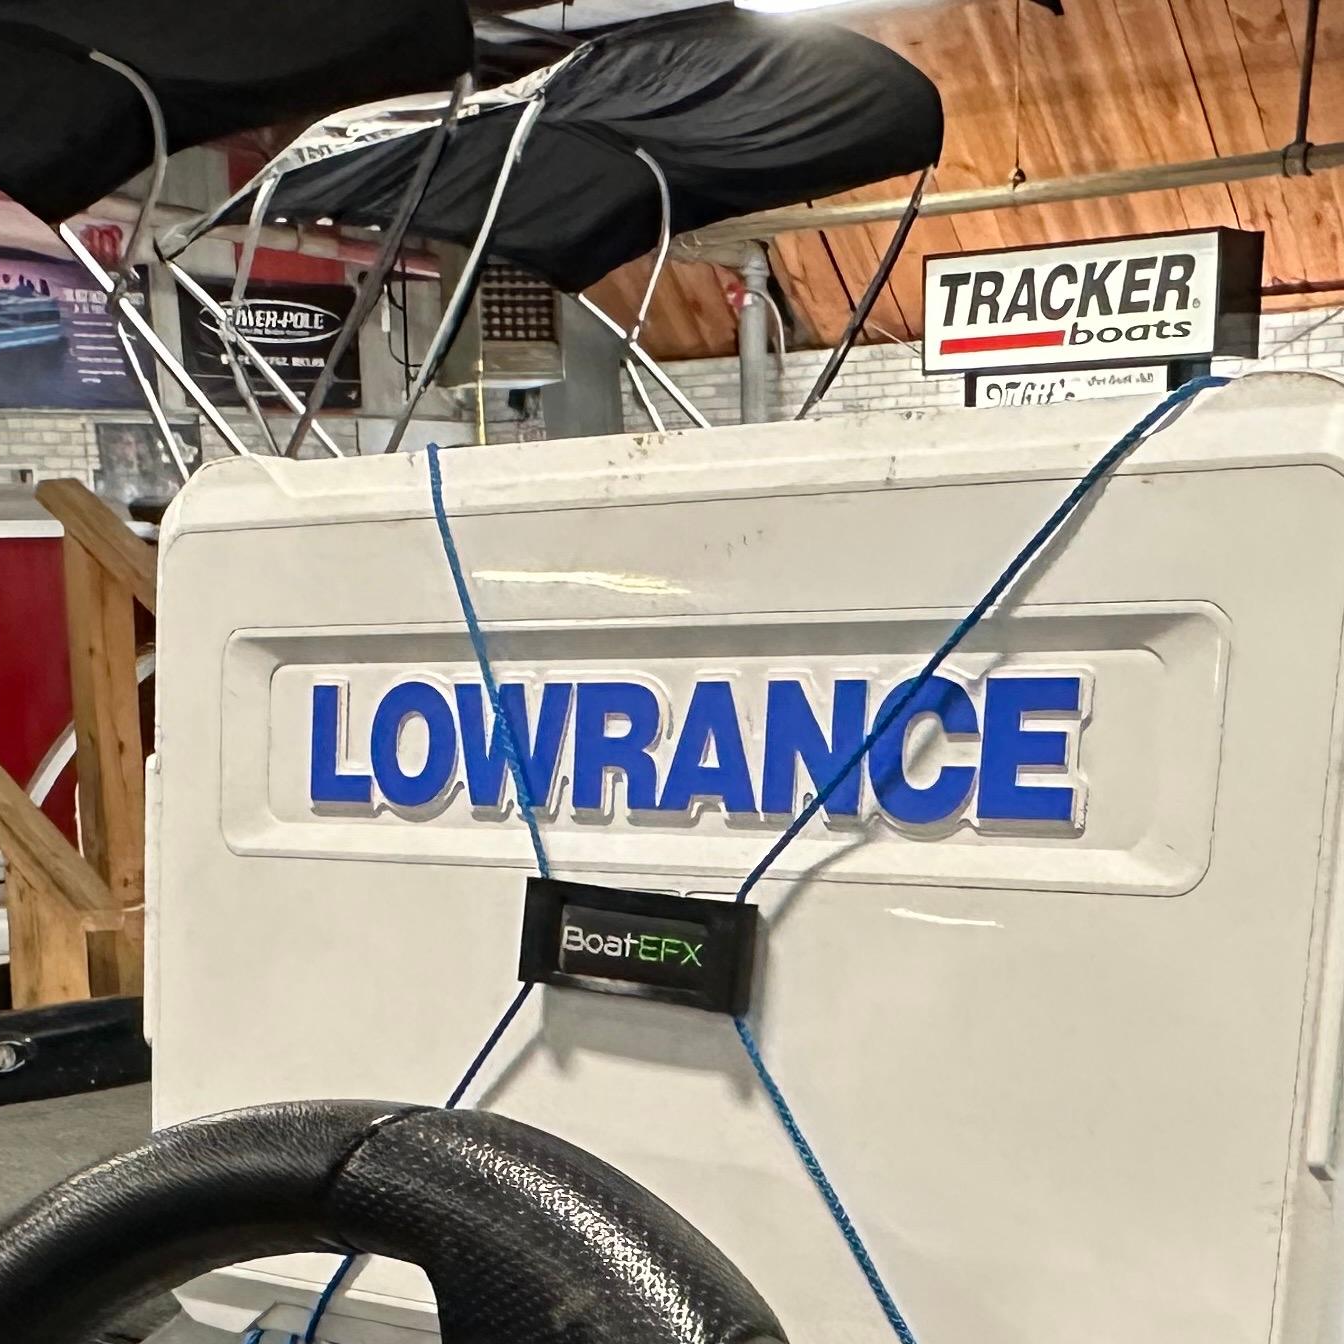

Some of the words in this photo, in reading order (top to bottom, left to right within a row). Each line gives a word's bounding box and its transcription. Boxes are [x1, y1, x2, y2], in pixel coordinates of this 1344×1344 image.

[940, 254, 1196, 327] TRACKER
[1068, 319, 1193, 346] boats
[309, 674, 1083, 826] LOWRANCE
[561, 925, 704, 967] BoatEFX
